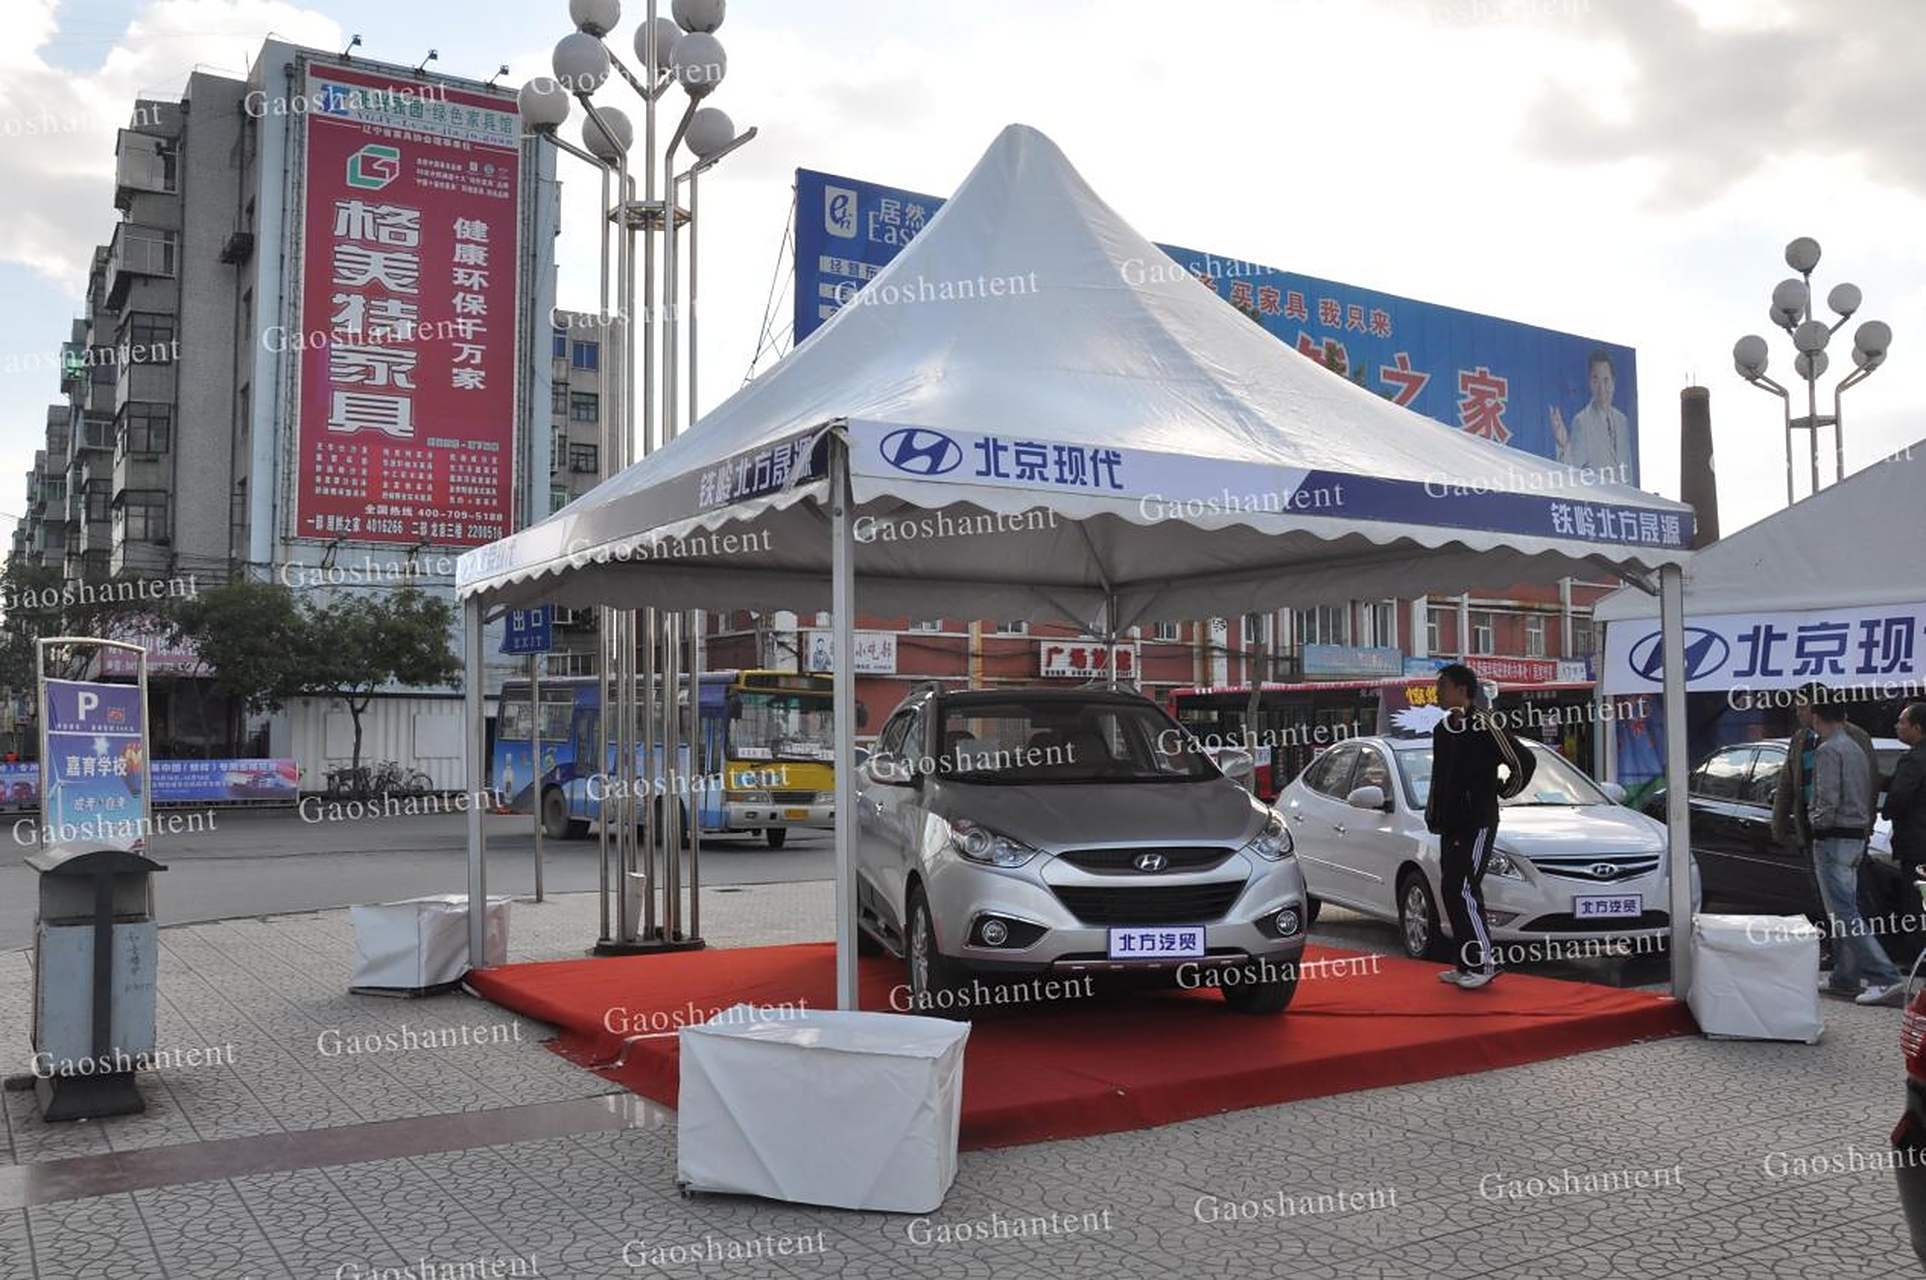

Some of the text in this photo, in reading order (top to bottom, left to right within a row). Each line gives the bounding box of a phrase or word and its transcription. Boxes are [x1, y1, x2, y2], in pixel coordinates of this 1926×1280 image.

[880, 198, 937, 230] 居然
[1231, 279, 1308, 322] 买家具
[1318, 297, 1393, 338] 我只来
[973, 436, 1125, 490] 北京现代
[1550, 502, 1682, 546] 铁岭北方晟源
[512, 608, 543, 632] 出口
[1732, 616, 1926, 678] 北京现
[77, 691, 99, 721] P
[1118, 931, 1197, 952] 北方汽贸
